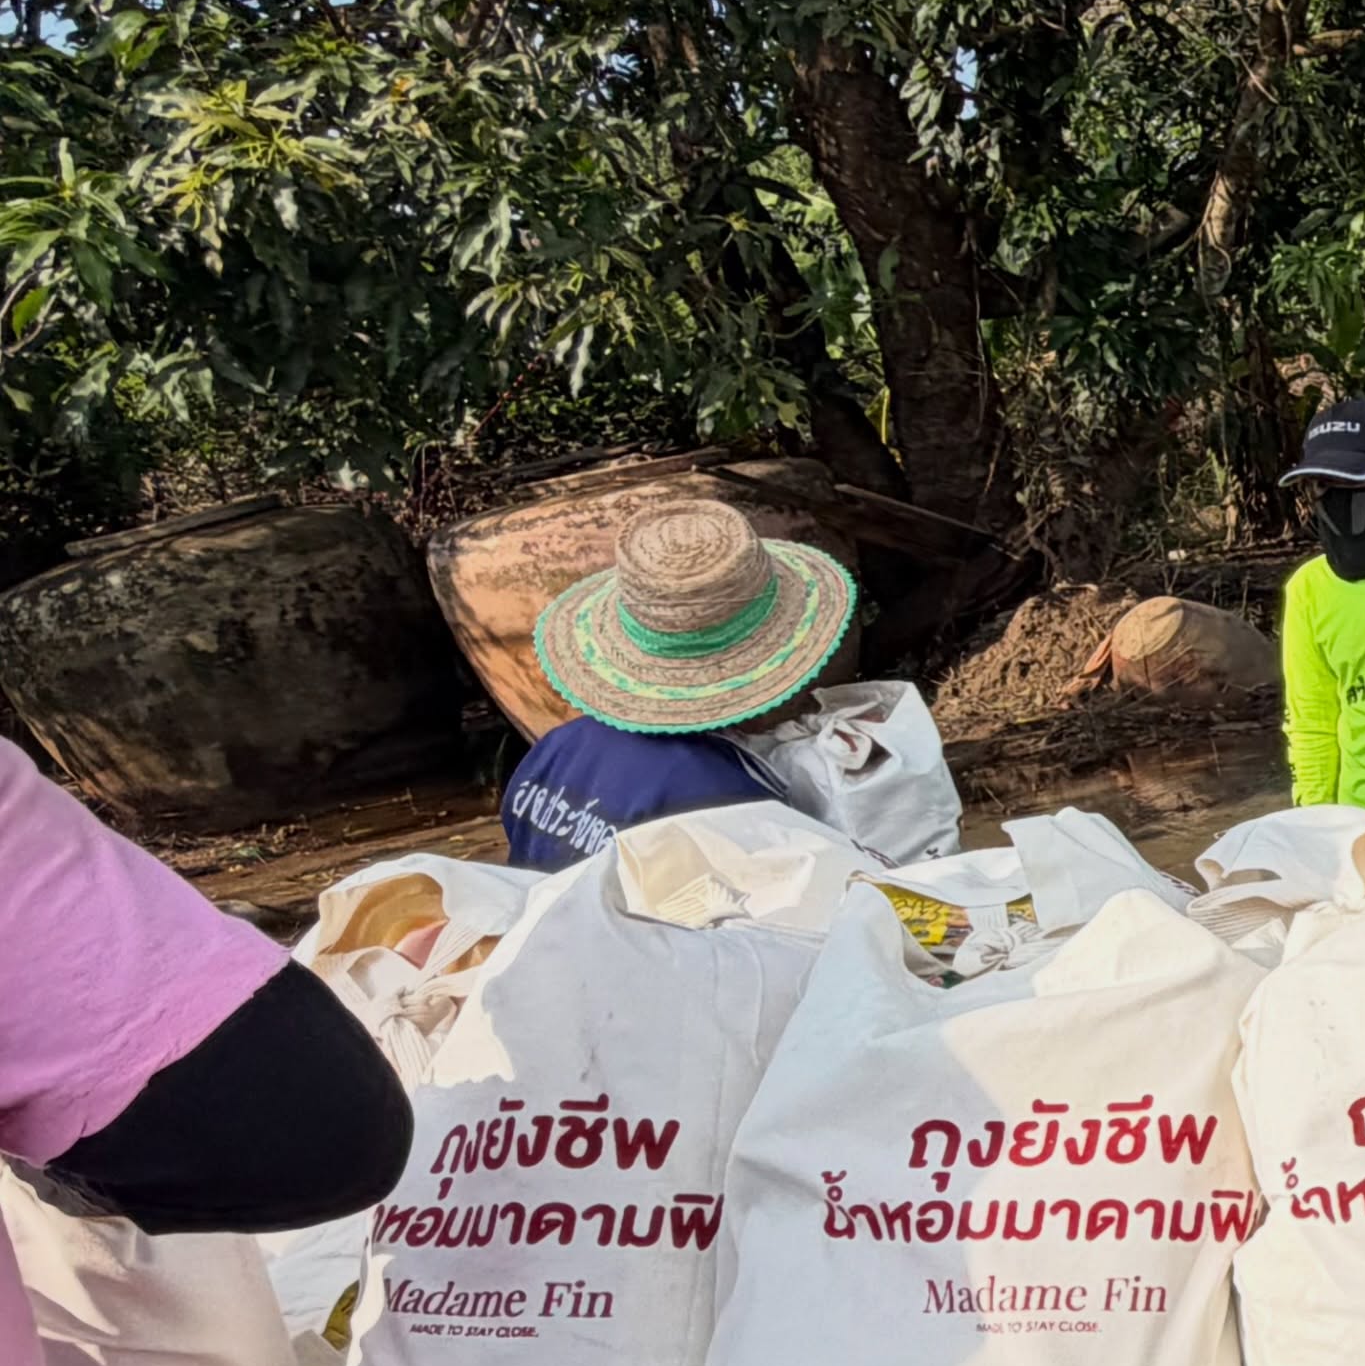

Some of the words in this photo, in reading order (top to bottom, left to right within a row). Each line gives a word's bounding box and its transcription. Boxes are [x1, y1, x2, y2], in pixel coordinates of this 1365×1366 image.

[430, 1093, 681, 1200] ถุงยังชีพ
[908, 1094, 1218, 1193] ถุงยังชีพ
[821, 1169, 1255, 1244] น้ำหอมมาดามฟิ
[383, 1277, 528, 1318] Madame
[538, 1280, 615, 1319] Fin
[922, 1275, 1088, 1314] Madame
[1101, 1276, 1168, 1313] Fin
[409, 1323, 445, 1336] MADE
[448, 1324, 463, 1336] TO
[465, 1325, 494, 1337] STAY
[1007, 1321, 1022, 1333] TO
[1025, 1321, 1056, 1333] STAY
